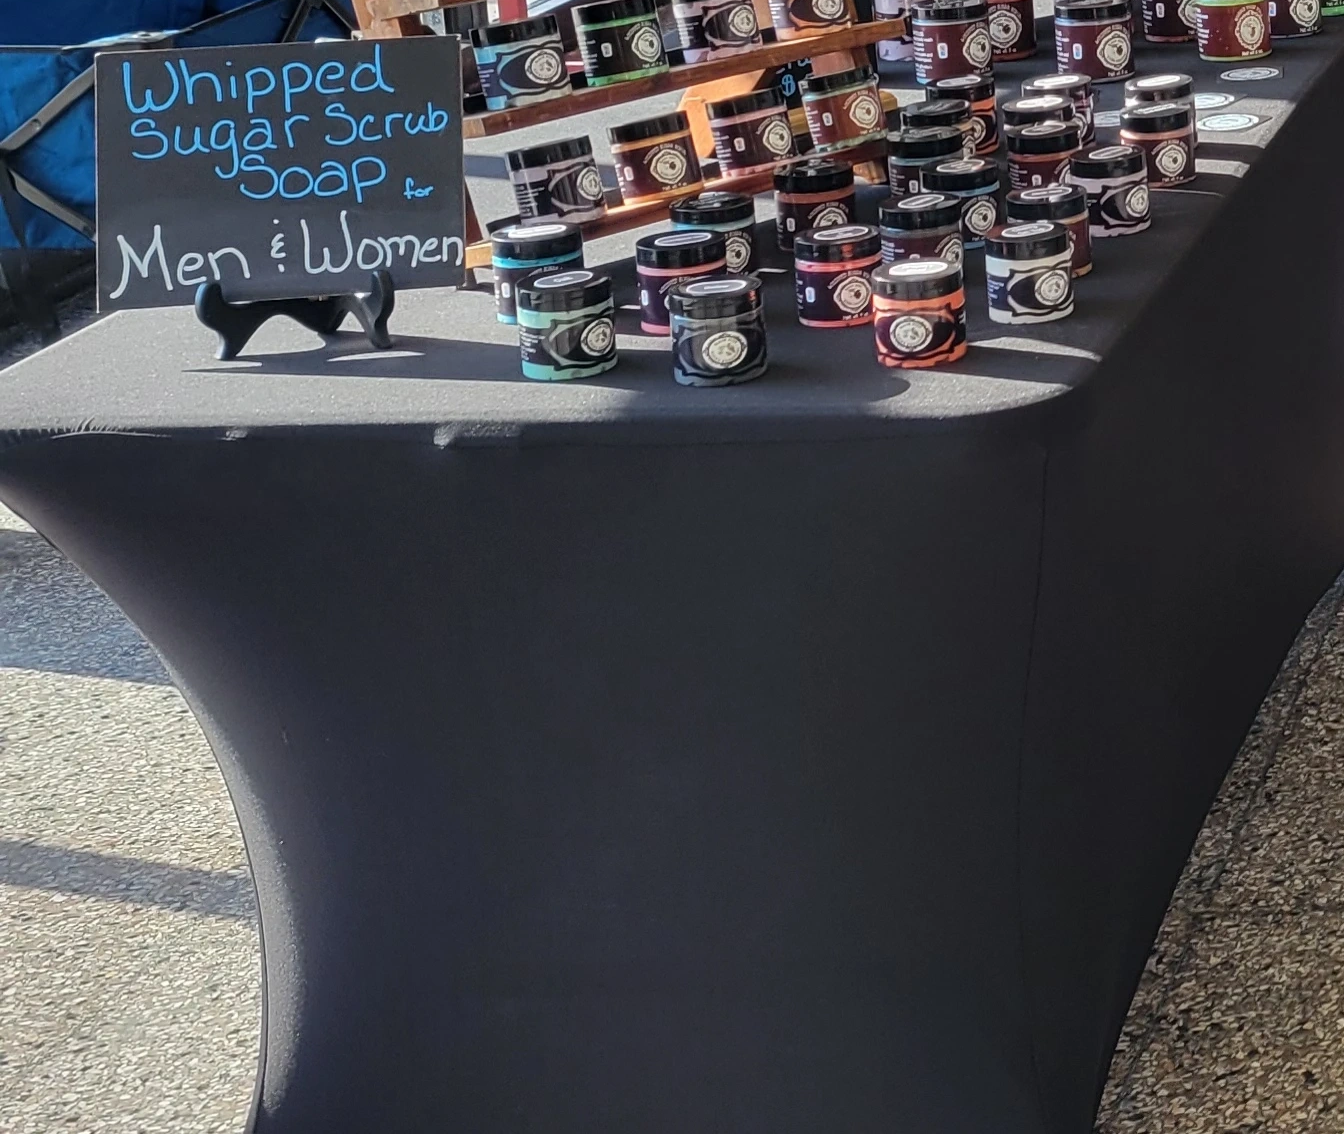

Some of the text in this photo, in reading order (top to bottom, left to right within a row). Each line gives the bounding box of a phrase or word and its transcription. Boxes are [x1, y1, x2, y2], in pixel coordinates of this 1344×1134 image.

[122, 43, 395, 114] Whipped
[130, 102, 449, 180] Sugar Scrub
[239, 154, 434, 203] Soap for
[109, 224, 251, 300] Men
[300, 210, 463, 275] Women
